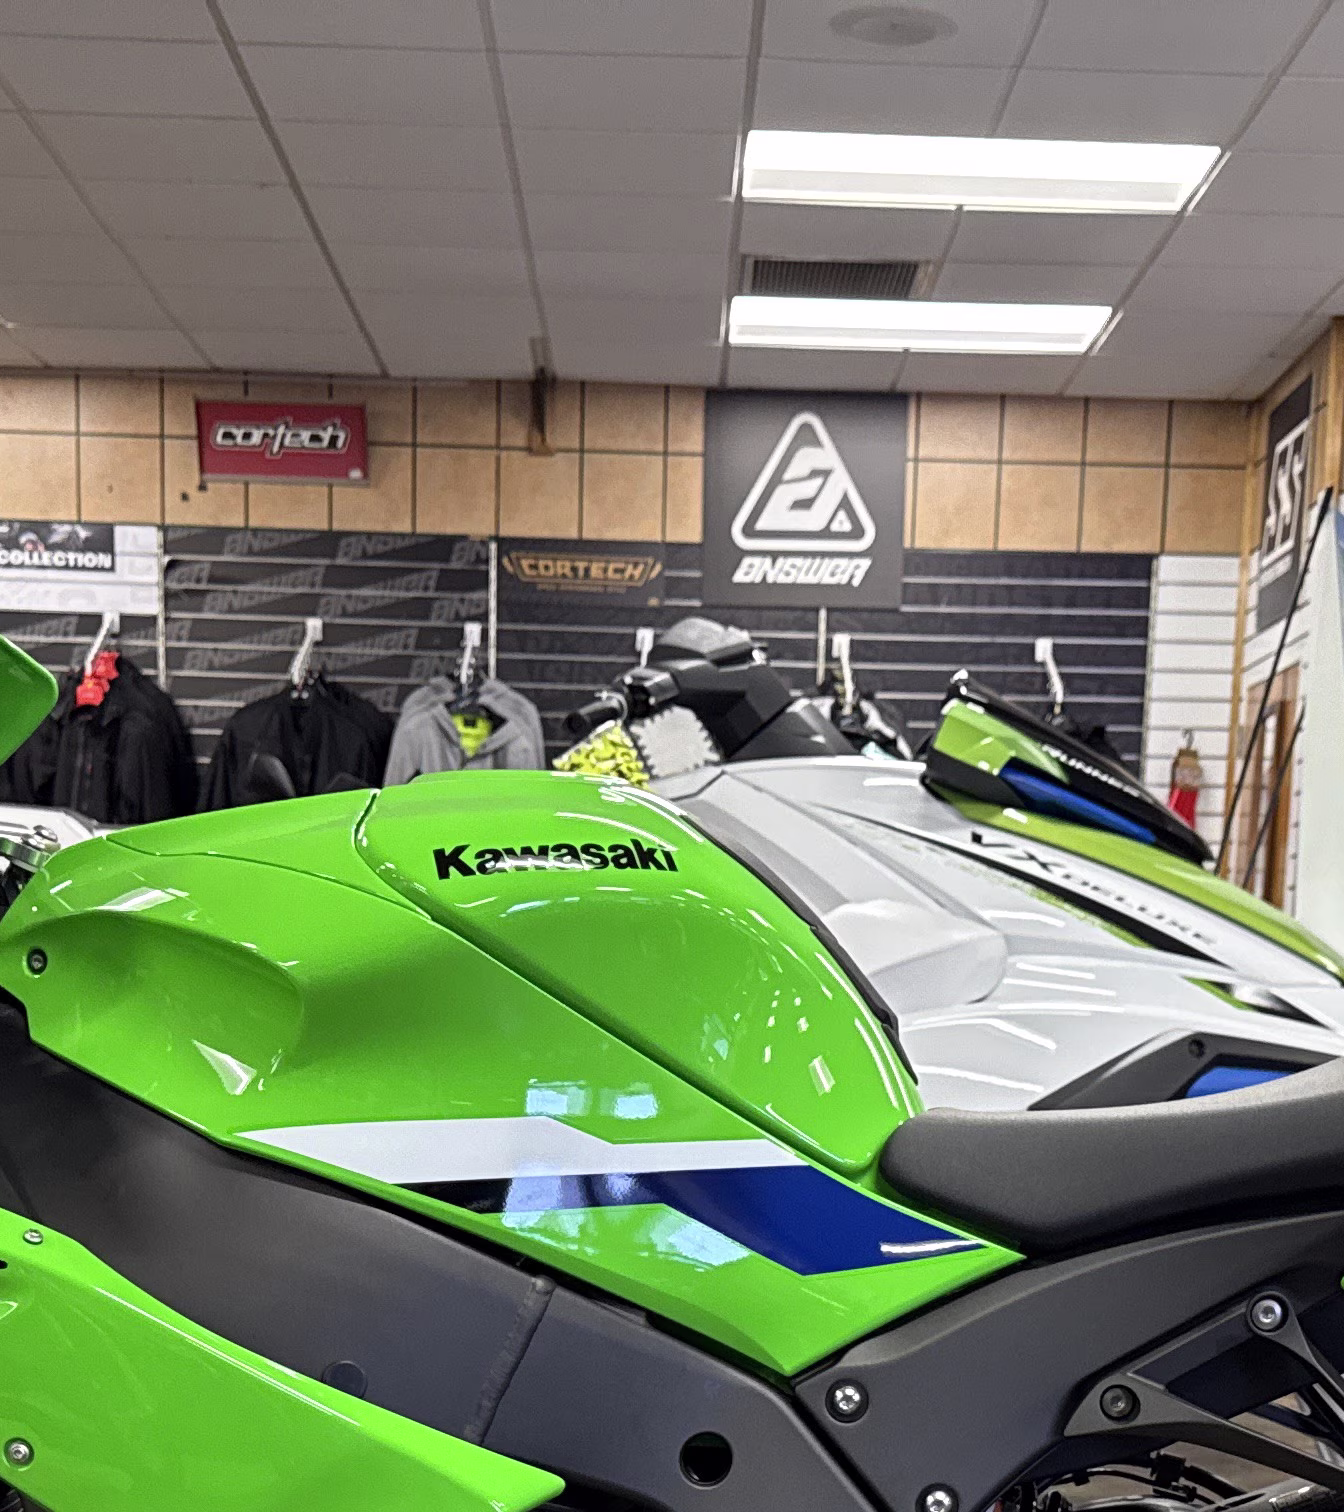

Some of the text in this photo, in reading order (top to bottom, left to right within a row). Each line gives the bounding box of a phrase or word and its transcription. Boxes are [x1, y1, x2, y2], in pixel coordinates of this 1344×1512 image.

[214, 422, 348, 455] cortech
[520, 557, 647, 582] CORTECH
[432, 838, 679, 881] Kawasaki
[971, 830, 1066, 875] VX
